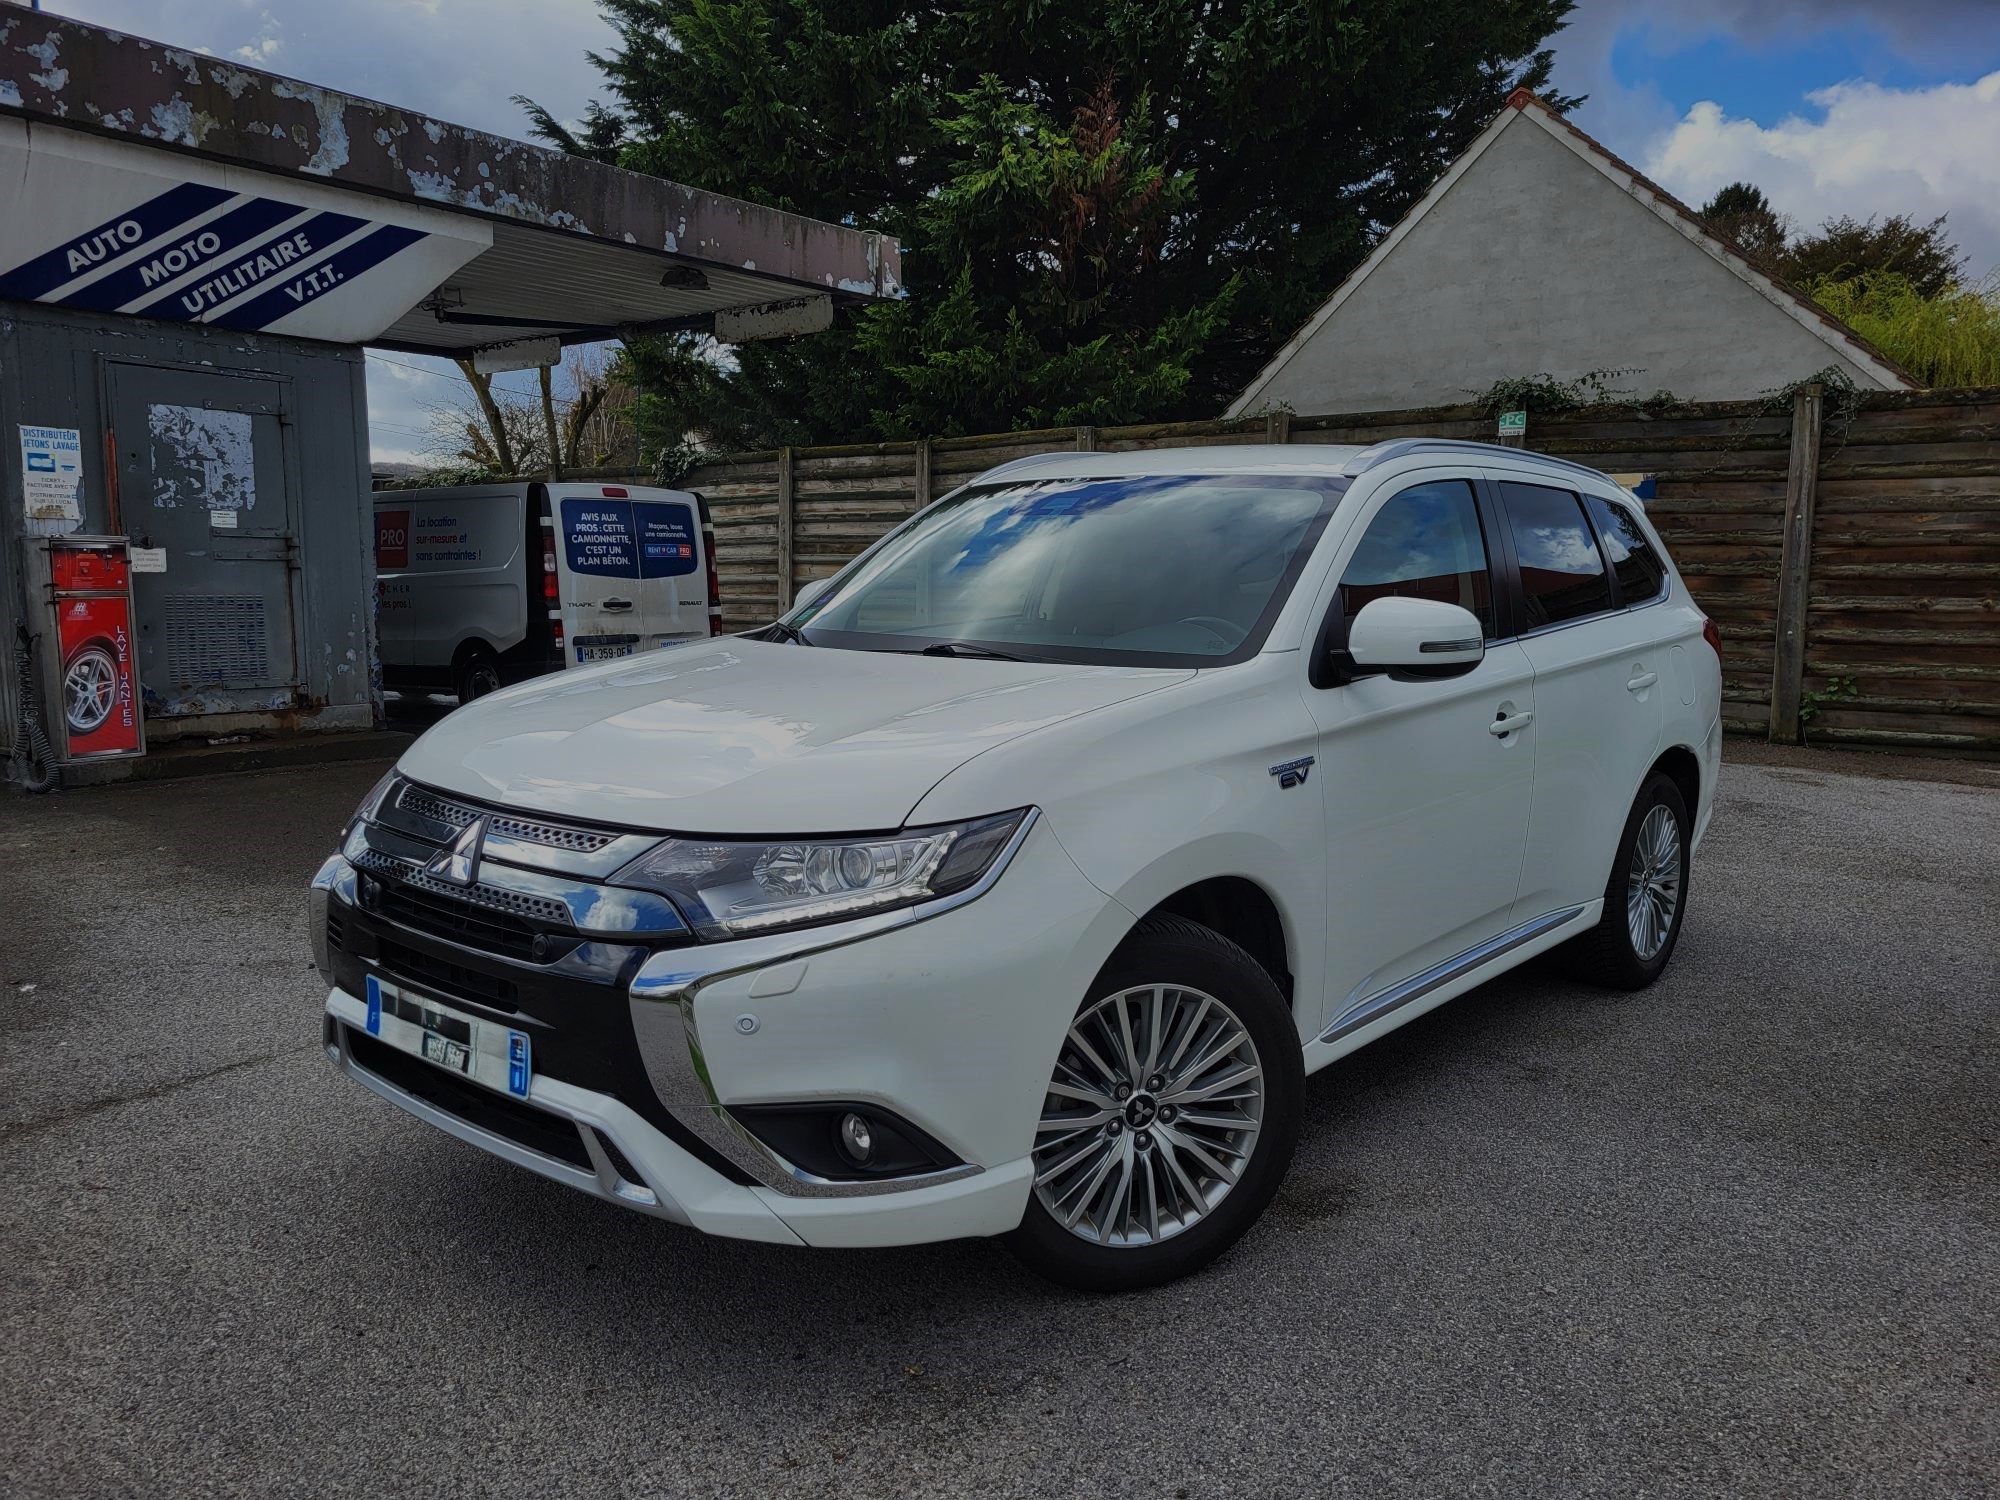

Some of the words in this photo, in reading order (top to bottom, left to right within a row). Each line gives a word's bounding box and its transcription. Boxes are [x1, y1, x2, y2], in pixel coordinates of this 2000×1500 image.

[65, 220, 143, 273] AUTO
[139, 232, 221, 287] MOTO
[181, 232, 312, 314] UTILITAIRE
[284, 263, 344, 302] V.T.T.
[23, 428, 77, 440] DISTRIBUTEUR
[23, 439, 49, 449] JETONS
[52, 441, 79, 451] LAVAGE
[417, 518, 426, 527] La
[427, 516, 457, 527] location
[581, 513, 599, 521] AVIS
[601, 513, 618, 522] AUX
[603, 524, 625, 533] CETTE
[648, 522, 669, 530] Maçons,
[380, 529, 404, 546] PRO
[416, 534, 458, 544] sur-mesure
[459, 533, 467, 543] et
[571, 534, 632, 544] CAMIONNETTE,
[416, 551, 433, 561] sans
[434, 550, 477, 560] contraintes
[609, 546, 621, 554] UN
[577, 557, 600, 565] PLAN
[602, 554, 630, 565] BÉTON.
[386, 584, 410, 593] CHER
[117, 625, 128, 662] LAVE
[120, 671, 133, 727] JANTES
[1278, 766, 1309, 790] EV
